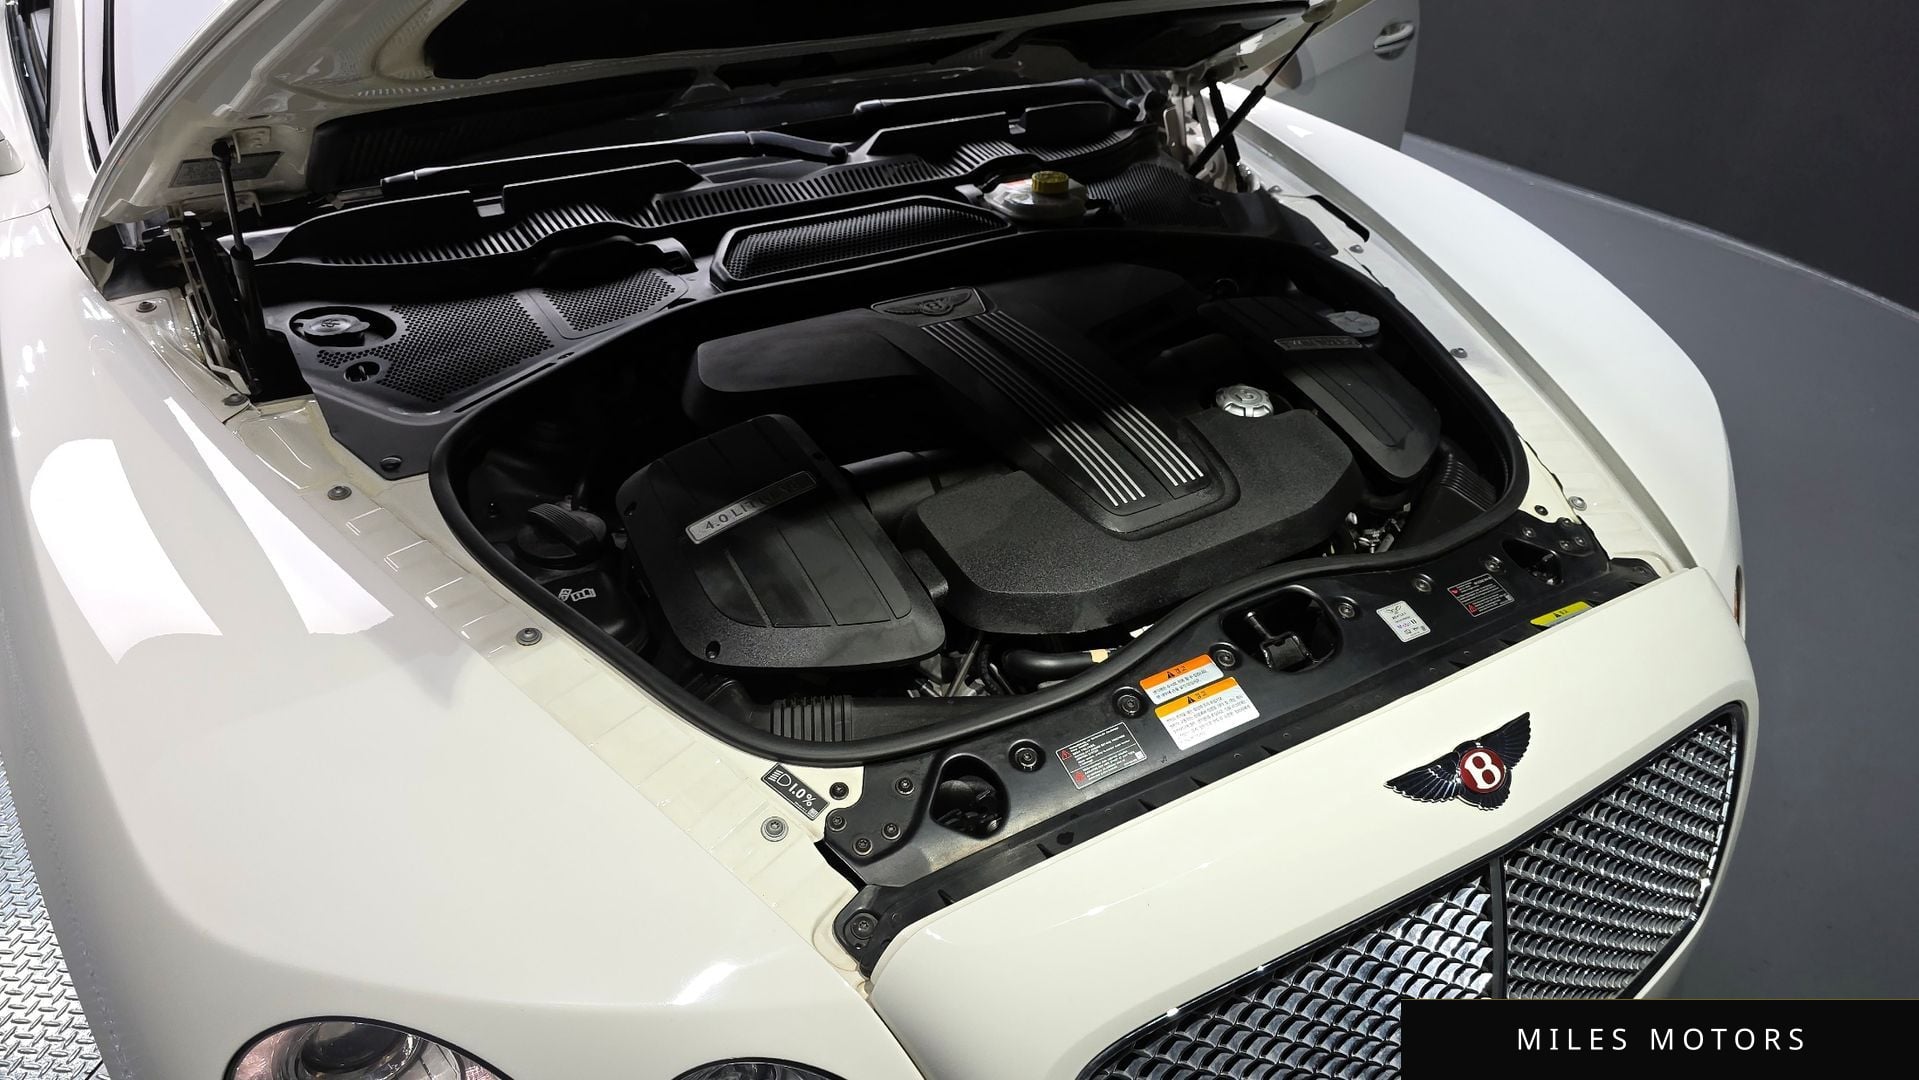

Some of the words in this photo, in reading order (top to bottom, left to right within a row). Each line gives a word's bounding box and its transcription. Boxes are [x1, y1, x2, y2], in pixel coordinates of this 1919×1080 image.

[705, 513, 729, 530] 4.0
[1464, 751, 1501, 789] B
[788, 782, 817, 807] 1.0%
